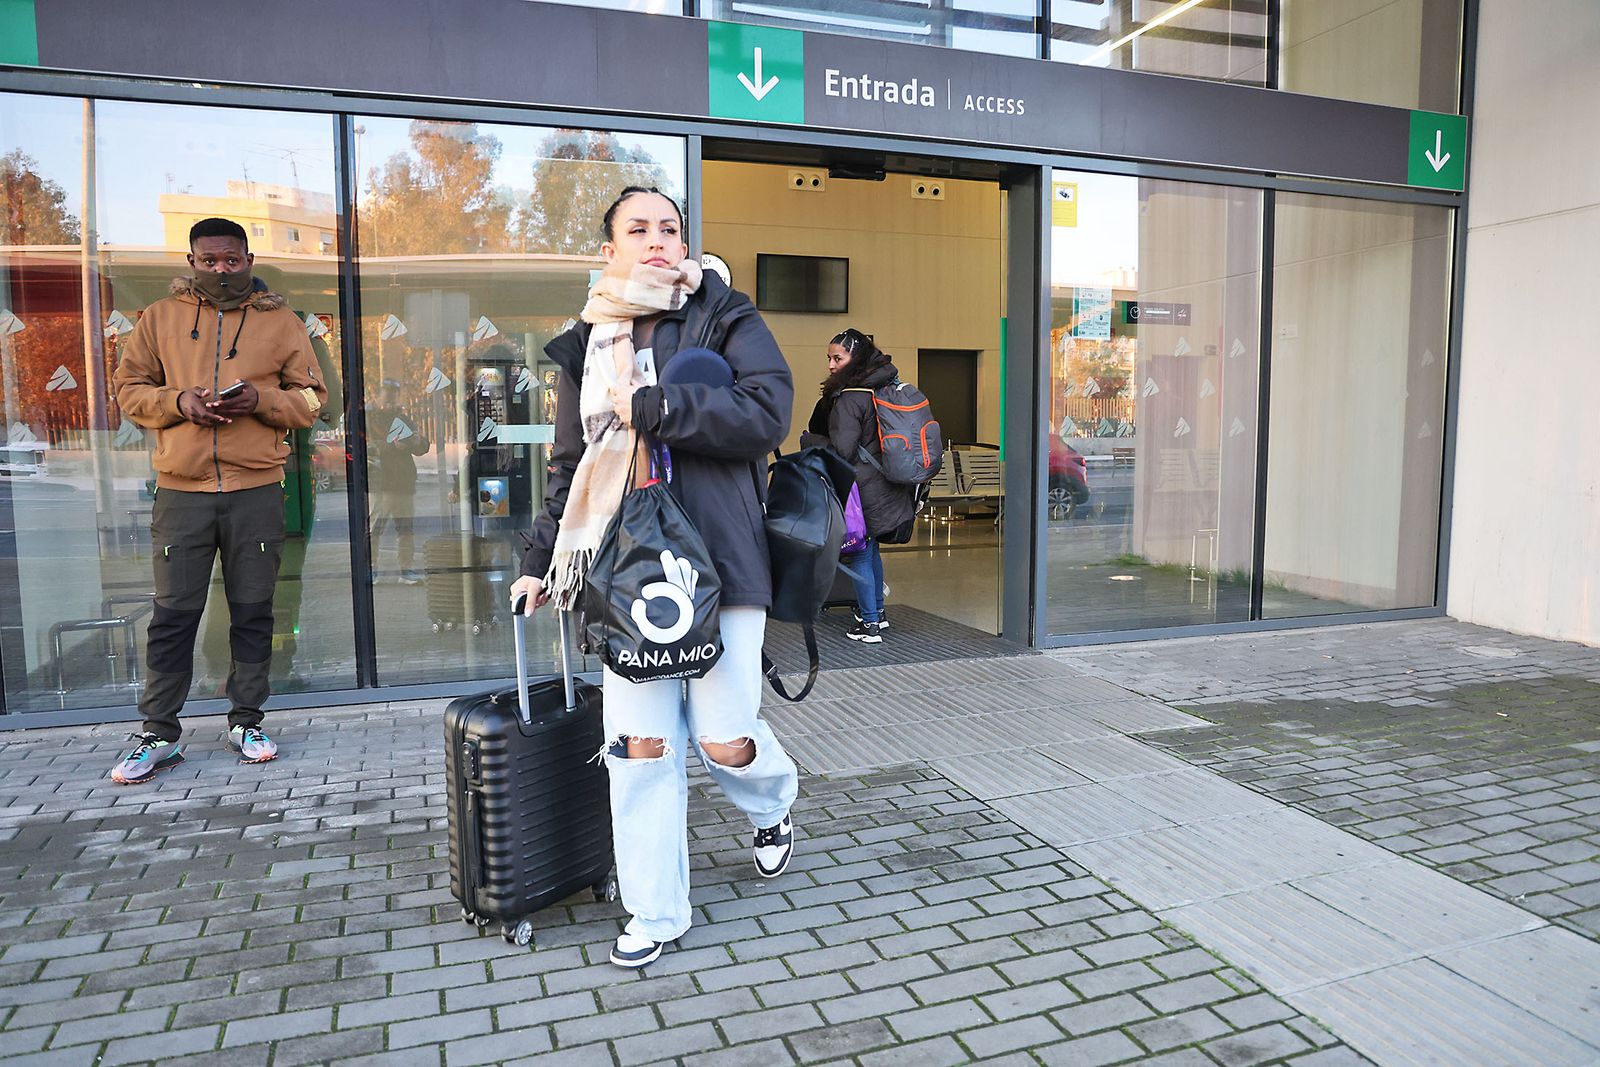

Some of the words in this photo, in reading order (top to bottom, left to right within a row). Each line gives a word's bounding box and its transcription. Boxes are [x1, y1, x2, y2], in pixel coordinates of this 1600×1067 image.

[825, 68, 935, 107] Entrada
[964, 94, 1025, 116] ACCESS
[618, 648, 673, 668] PANA
[678, 643, 717, 664] MIO
